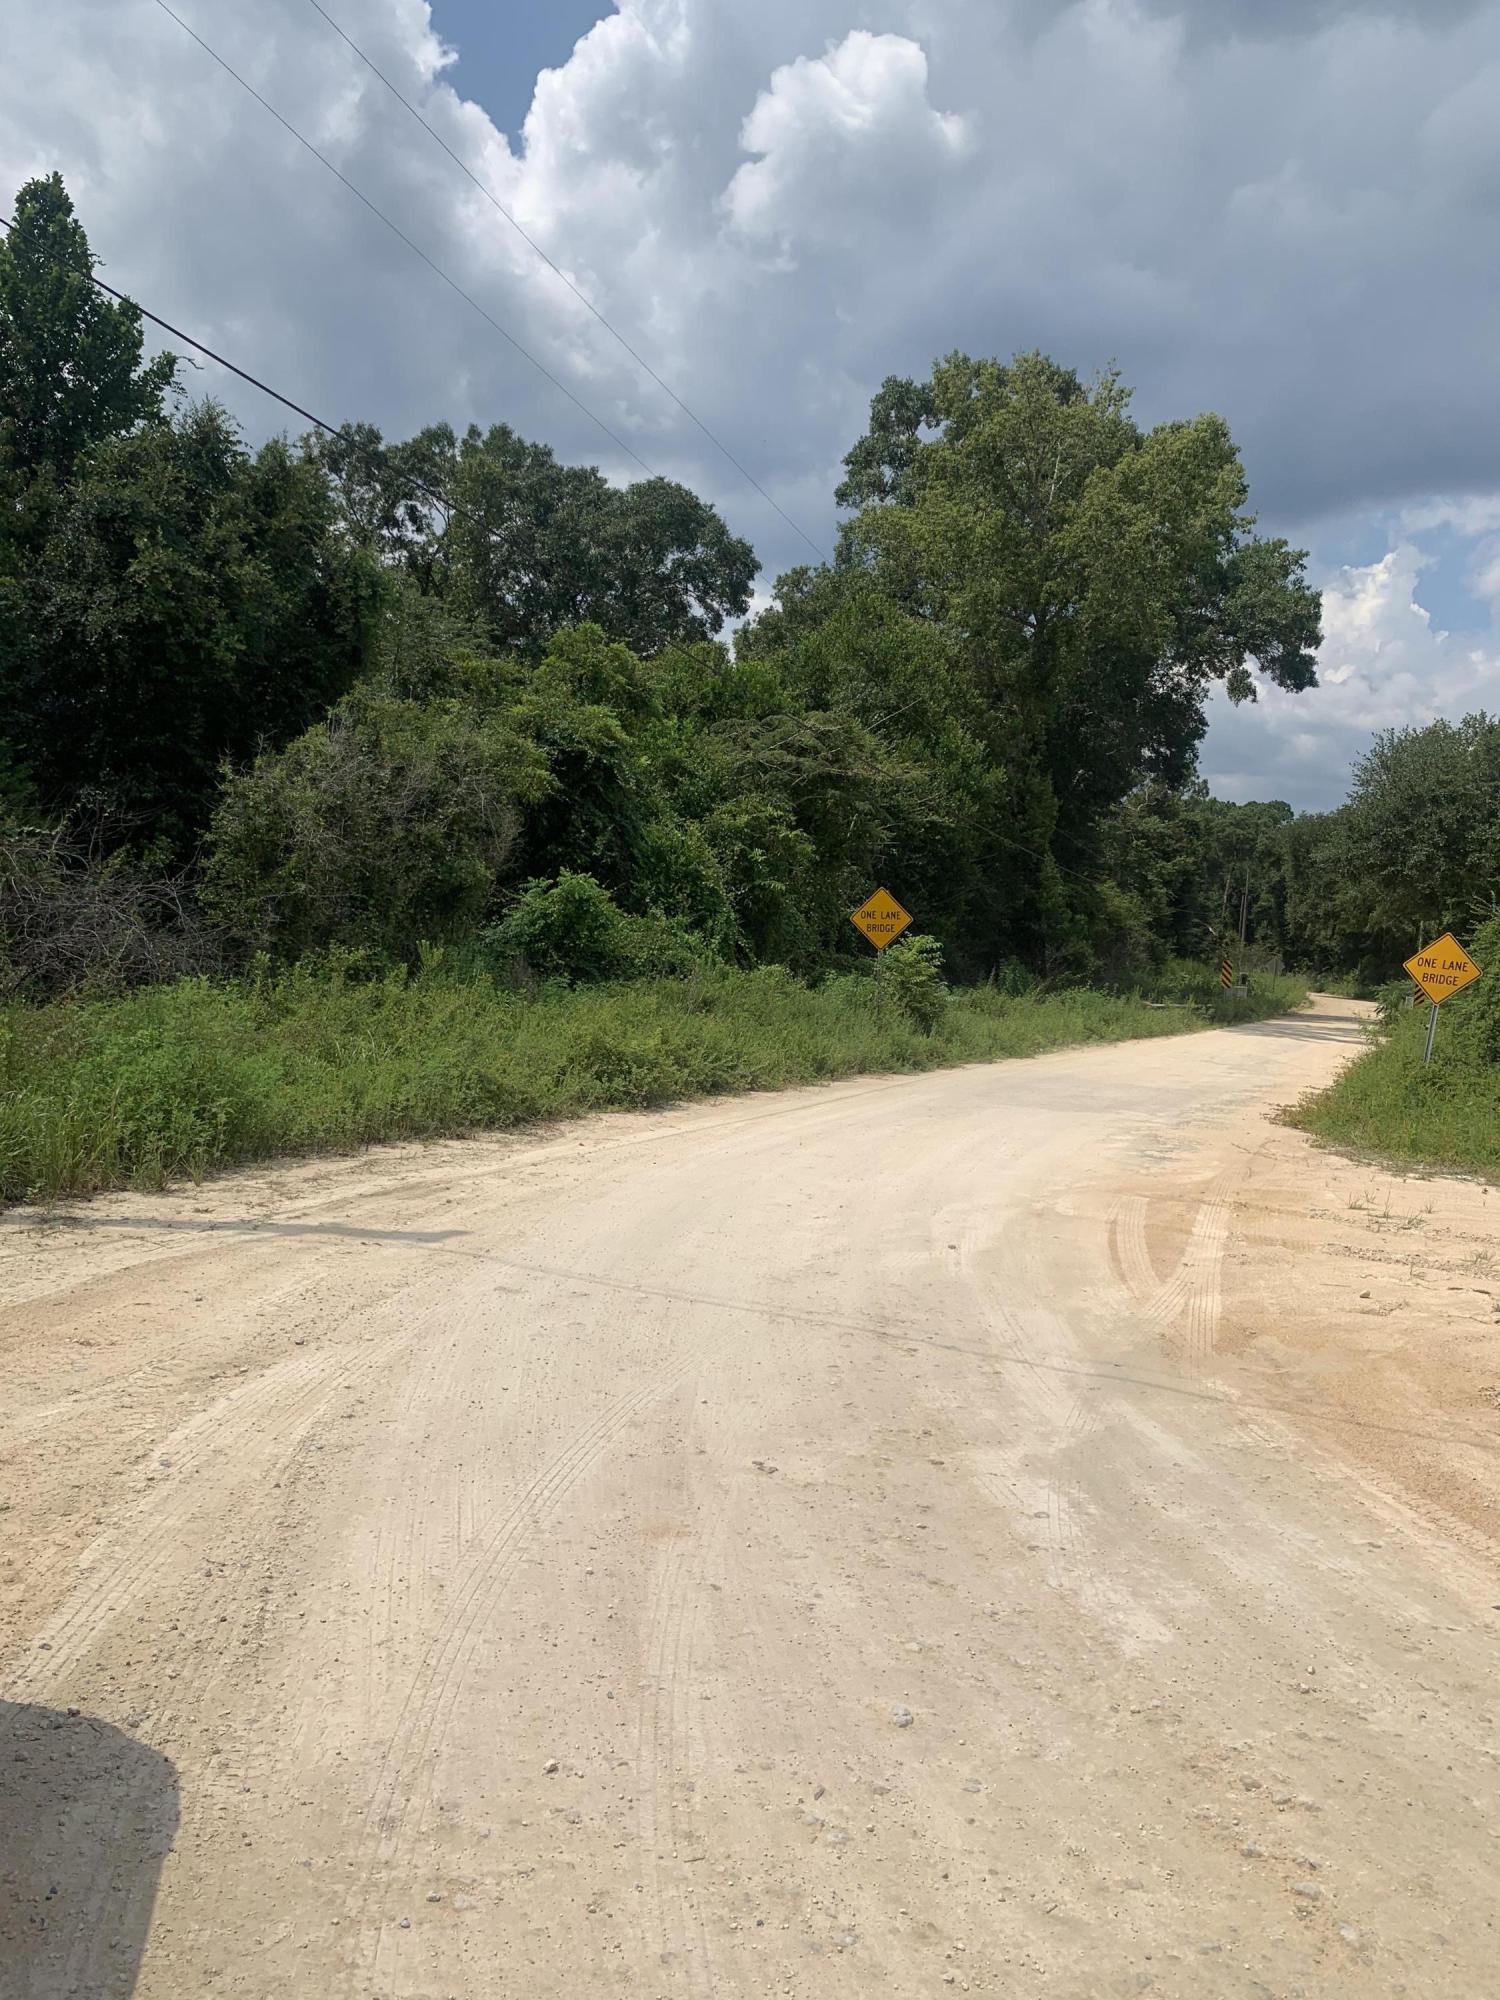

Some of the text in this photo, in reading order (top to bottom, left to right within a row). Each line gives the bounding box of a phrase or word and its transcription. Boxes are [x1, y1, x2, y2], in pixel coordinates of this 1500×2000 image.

[860, 910, 902, 920] ONE LANE
[866, 923, 895, 933] BRIDGE
[1417, 957, 1470, 972] ONE LANE
[1422, 972, 1460, 986] BRIDGE
